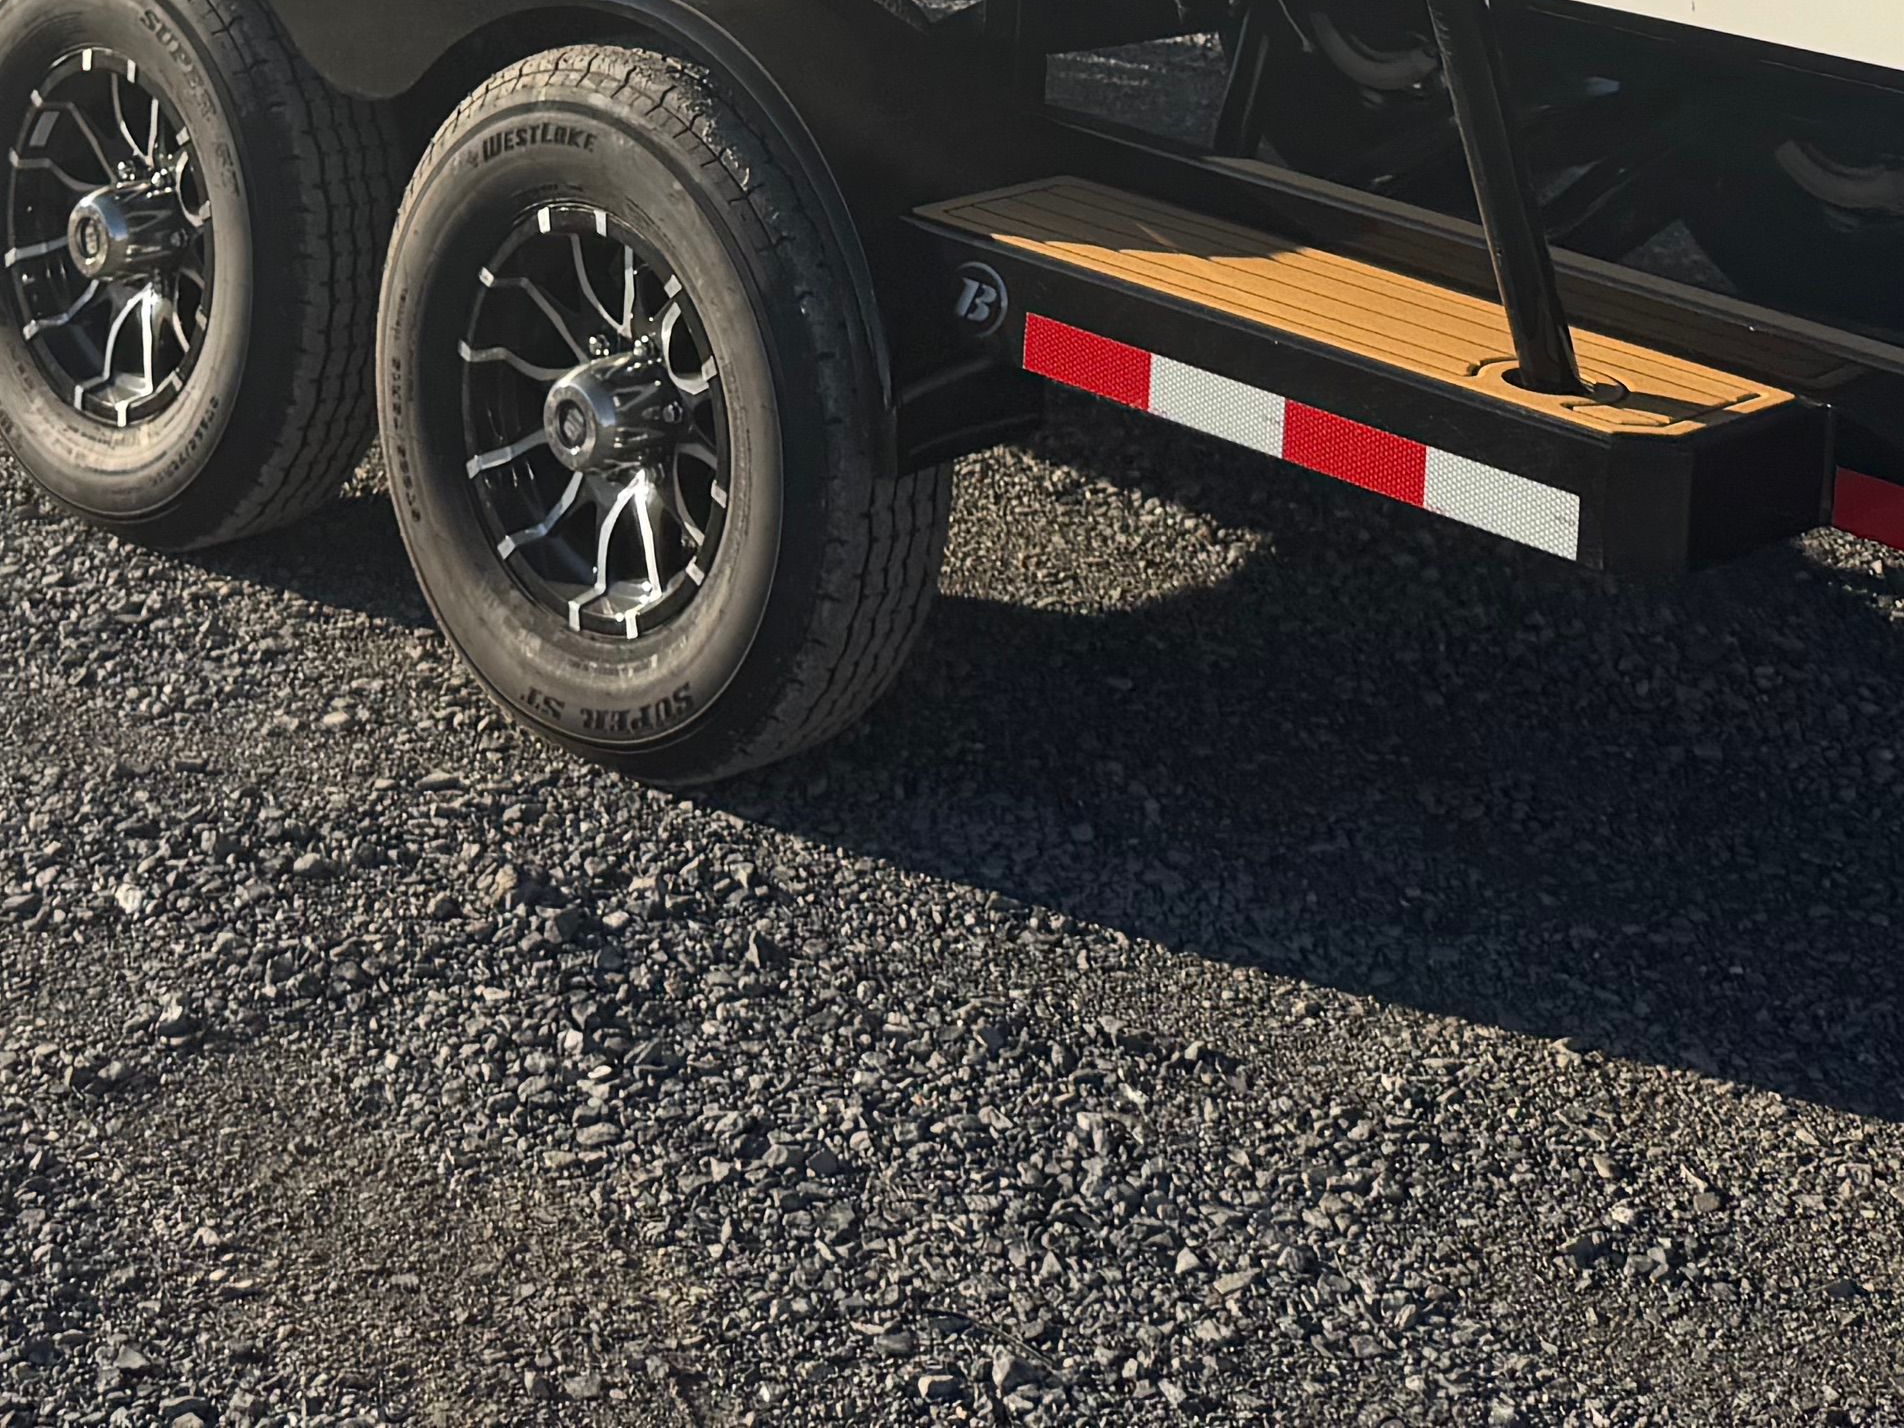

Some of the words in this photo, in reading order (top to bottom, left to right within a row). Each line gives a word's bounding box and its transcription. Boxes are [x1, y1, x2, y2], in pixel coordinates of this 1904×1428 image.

[139, 8, 217, 122] SUPER
[482, 121, 597, 162] WESTLAKE
[580, 681, 696, 734] SUPER
